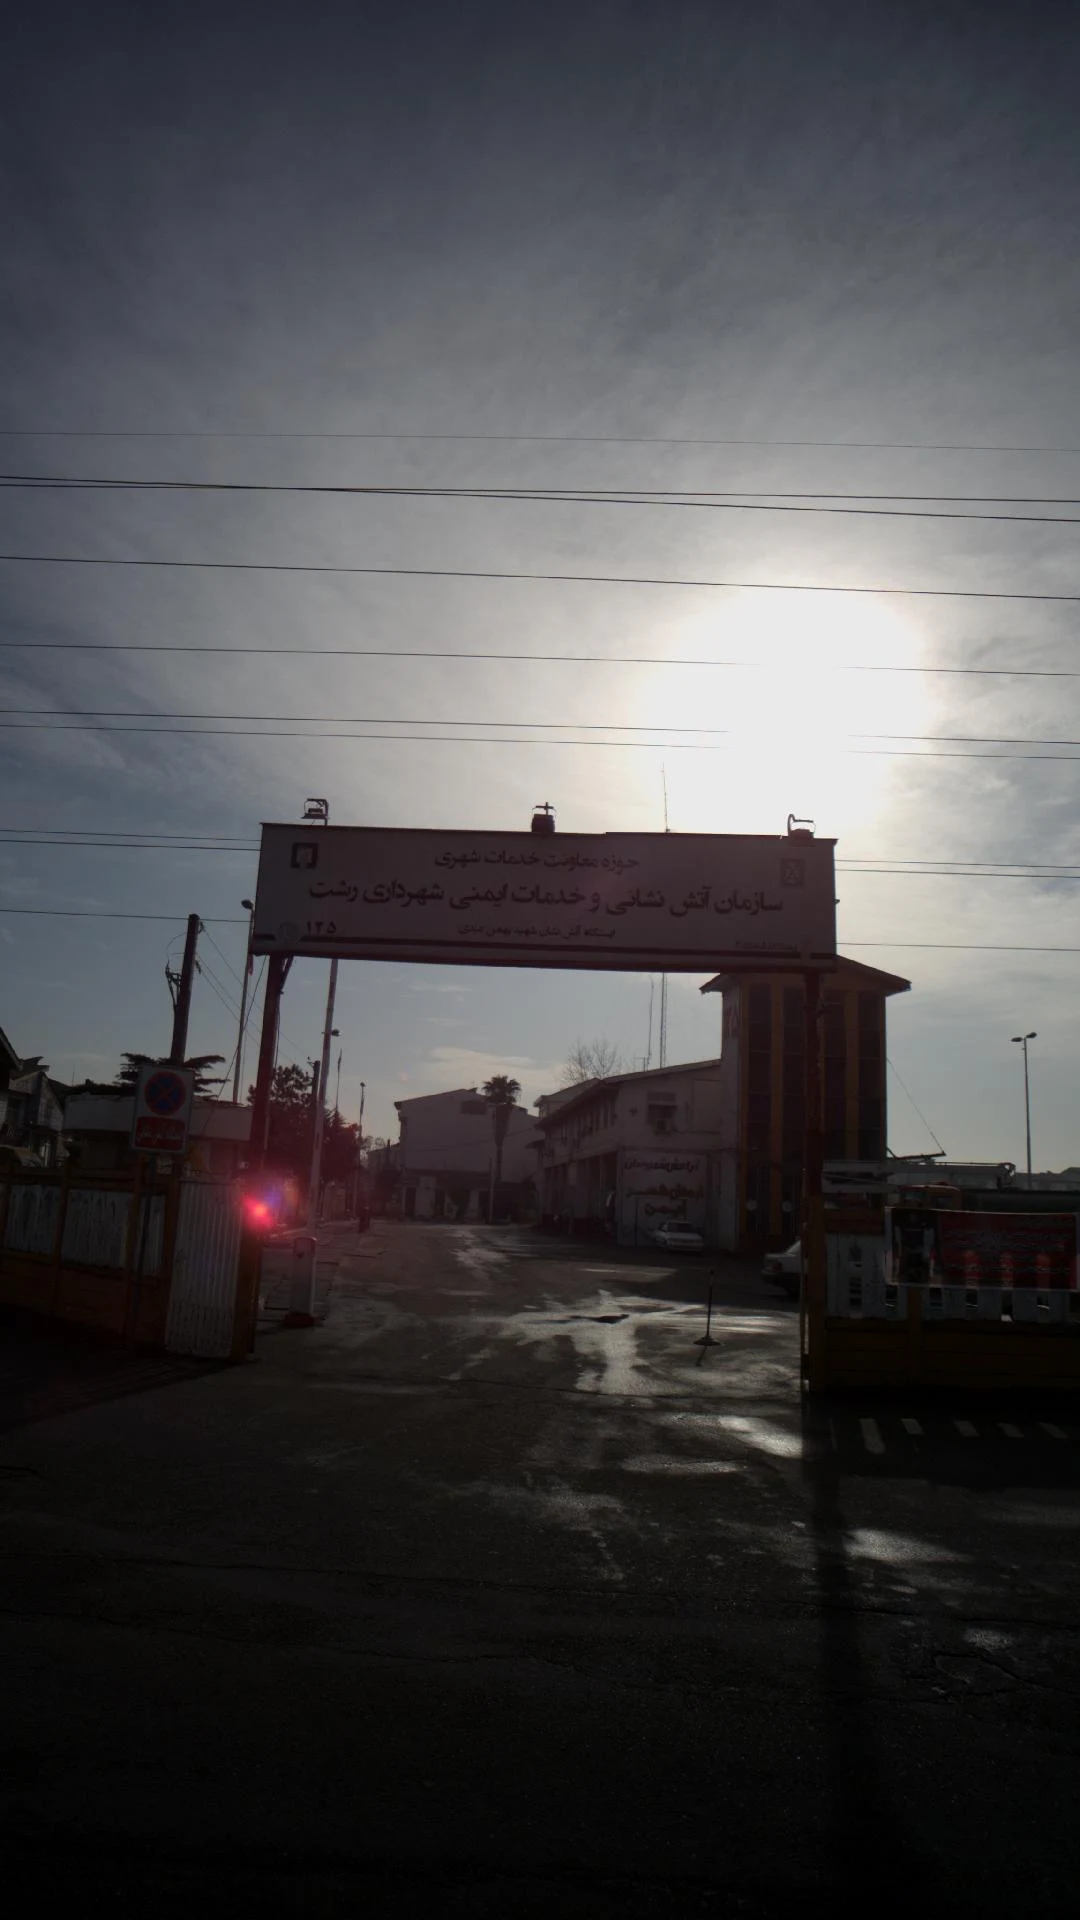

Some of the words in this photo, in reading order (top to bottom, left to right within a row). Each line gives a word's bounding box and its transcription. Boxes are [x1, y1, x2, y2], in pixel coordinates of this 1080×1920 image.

[435, 850, 481, 869] شهری
[484, 850, 541, 865] خدمات
[543, 852, 600, 872] معاونت
[601, 854, 640, 875] حوزه
[308, 880, 358, 902] رشت
[362, 879, 446, 907] شهرداری
[449, 882, 509, 909] ایمنی
[511, 884, 587, 905] خدمات
[605, 887, 665, 915] نشانی
[669, 886, 712, 917] آتش
[584, 892, 601, 914] و
[713, 890, 784, 916] سازمان
